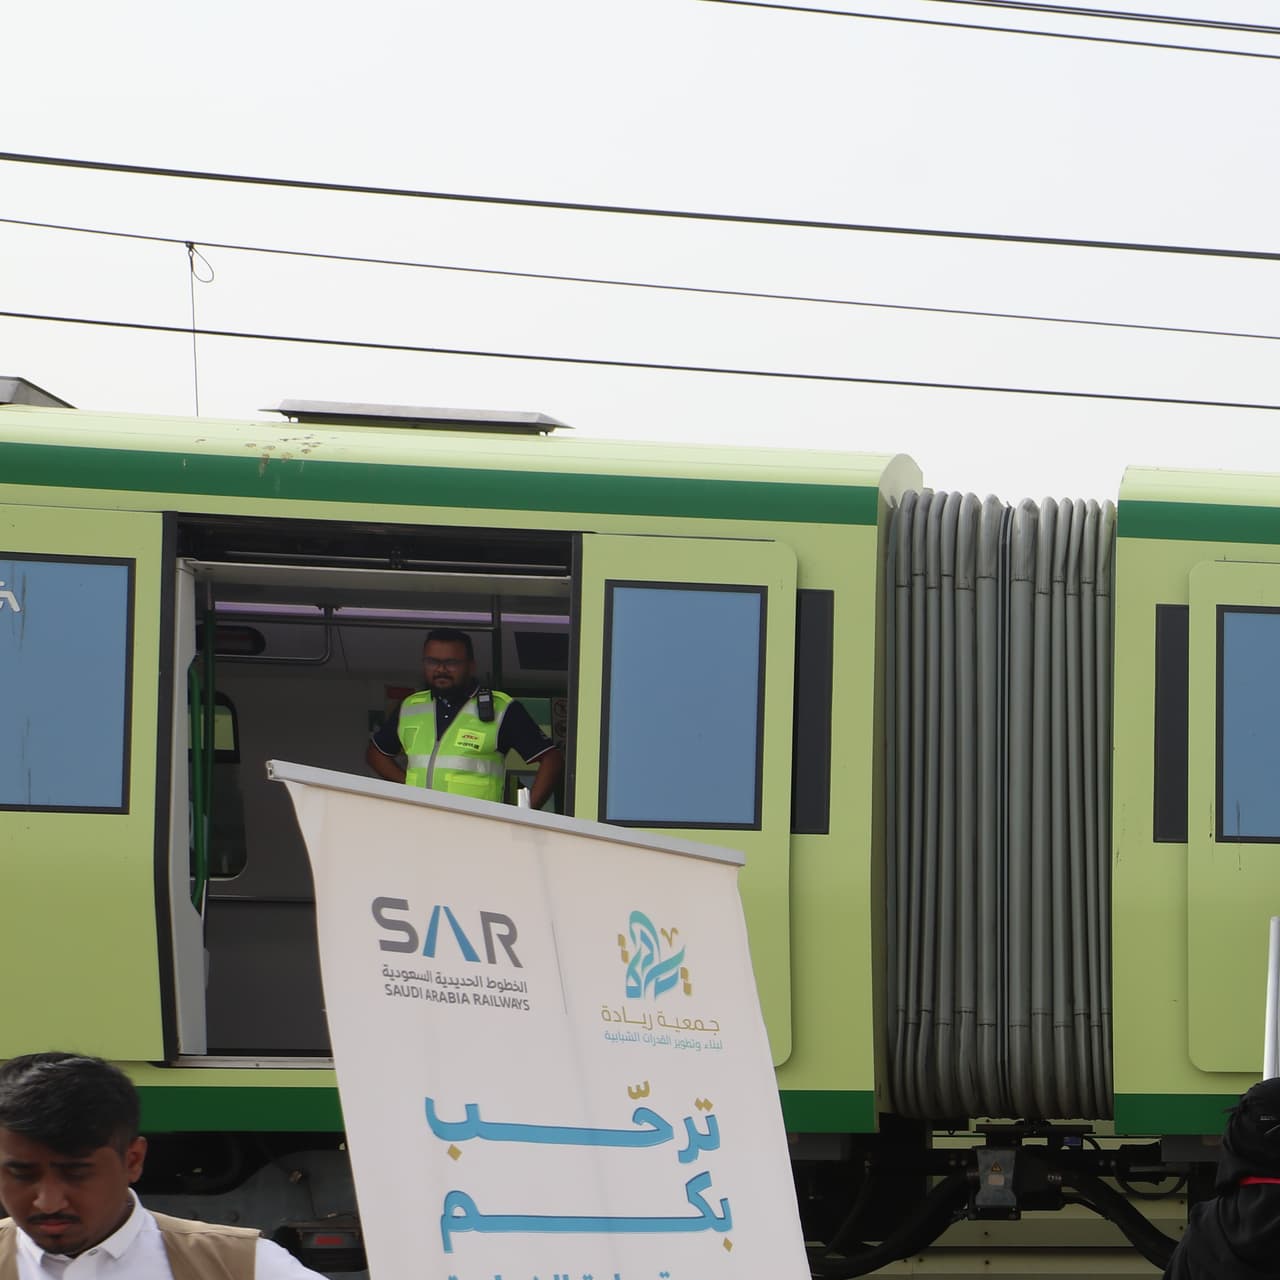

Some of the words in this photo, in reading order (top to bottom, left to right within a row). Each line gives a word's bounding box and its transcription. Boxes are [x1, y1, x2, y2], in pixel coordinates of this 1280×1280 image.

[371, 896, 524, 969] SAR
[382, 964, 433, 983] السعودية
[435, 971, 483, 989] الحديدية
[486, 977, 528, 994] الخطوط
[384, 984, 423, 1000] SAUDI
[425, 989, 471, 1005] ARABIA
[472, 993, 530, 1011] RAILWAYS
[600, 1005, 653, 1031] ريادة
[657, 1011, 720, 1036] جمعية
[440, 1171, 733, 1254] بكم
